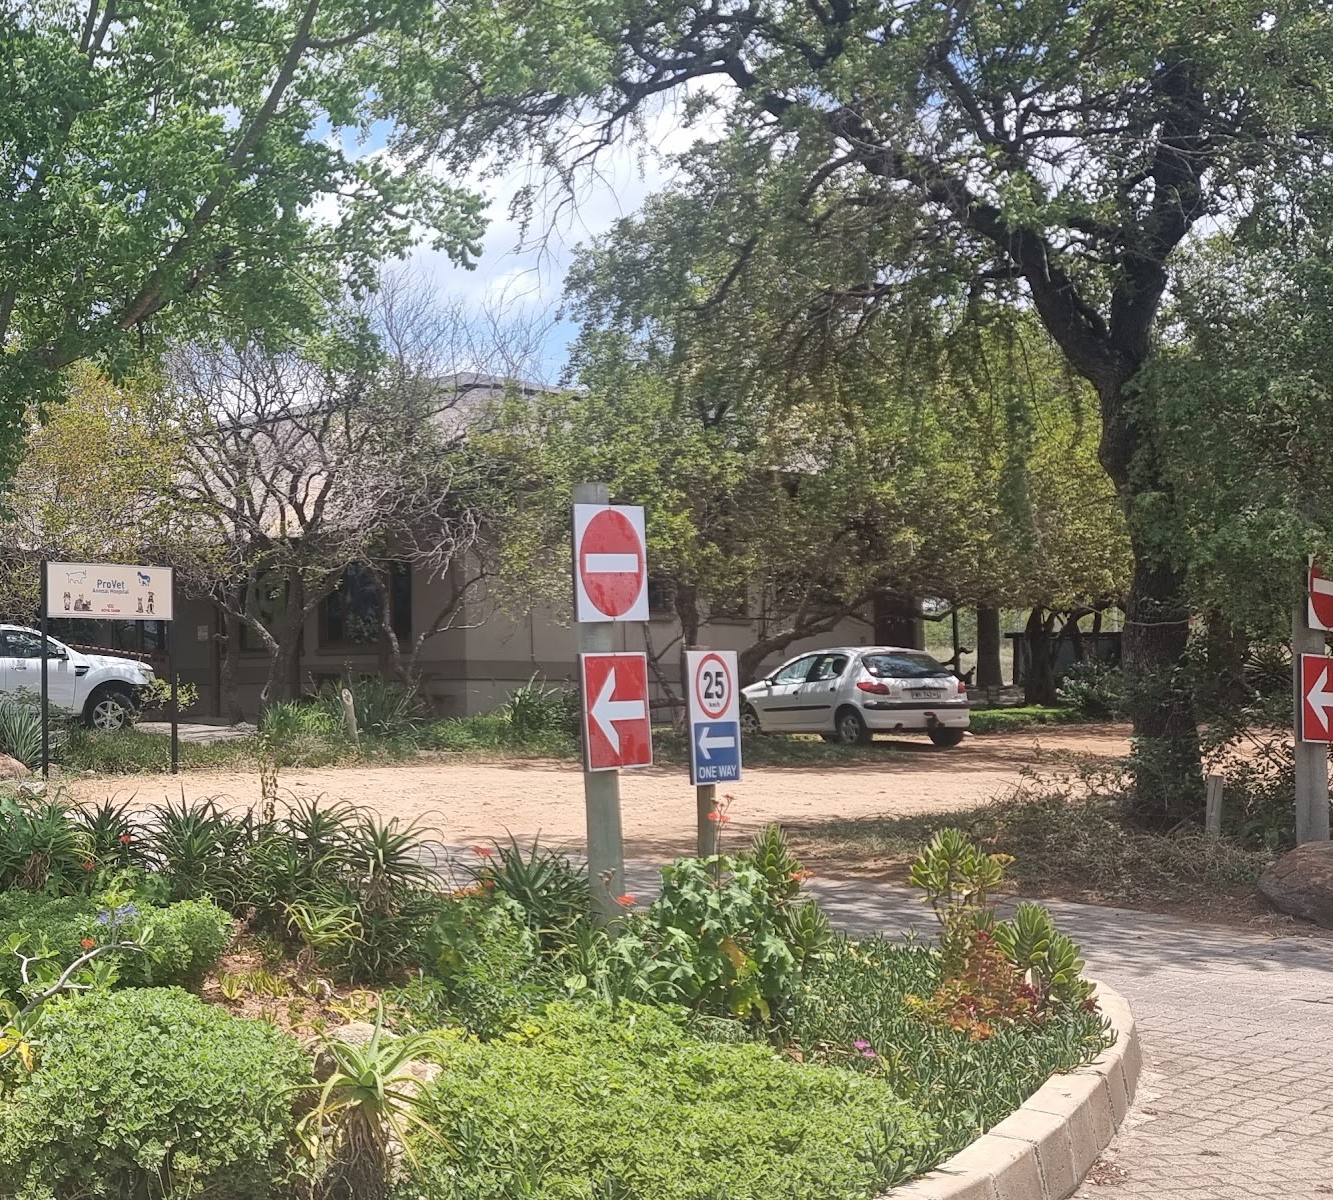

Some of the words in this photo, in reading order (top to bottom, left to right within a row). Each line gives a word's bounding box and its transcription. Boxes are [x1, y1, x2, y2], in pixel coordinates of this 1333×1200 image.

[97, 579, 125, 588] ProVet
[703, 671, 725, 699] 25
[698, 766, 717, 779] ONE
[718, 764, 737, 777] WAY
